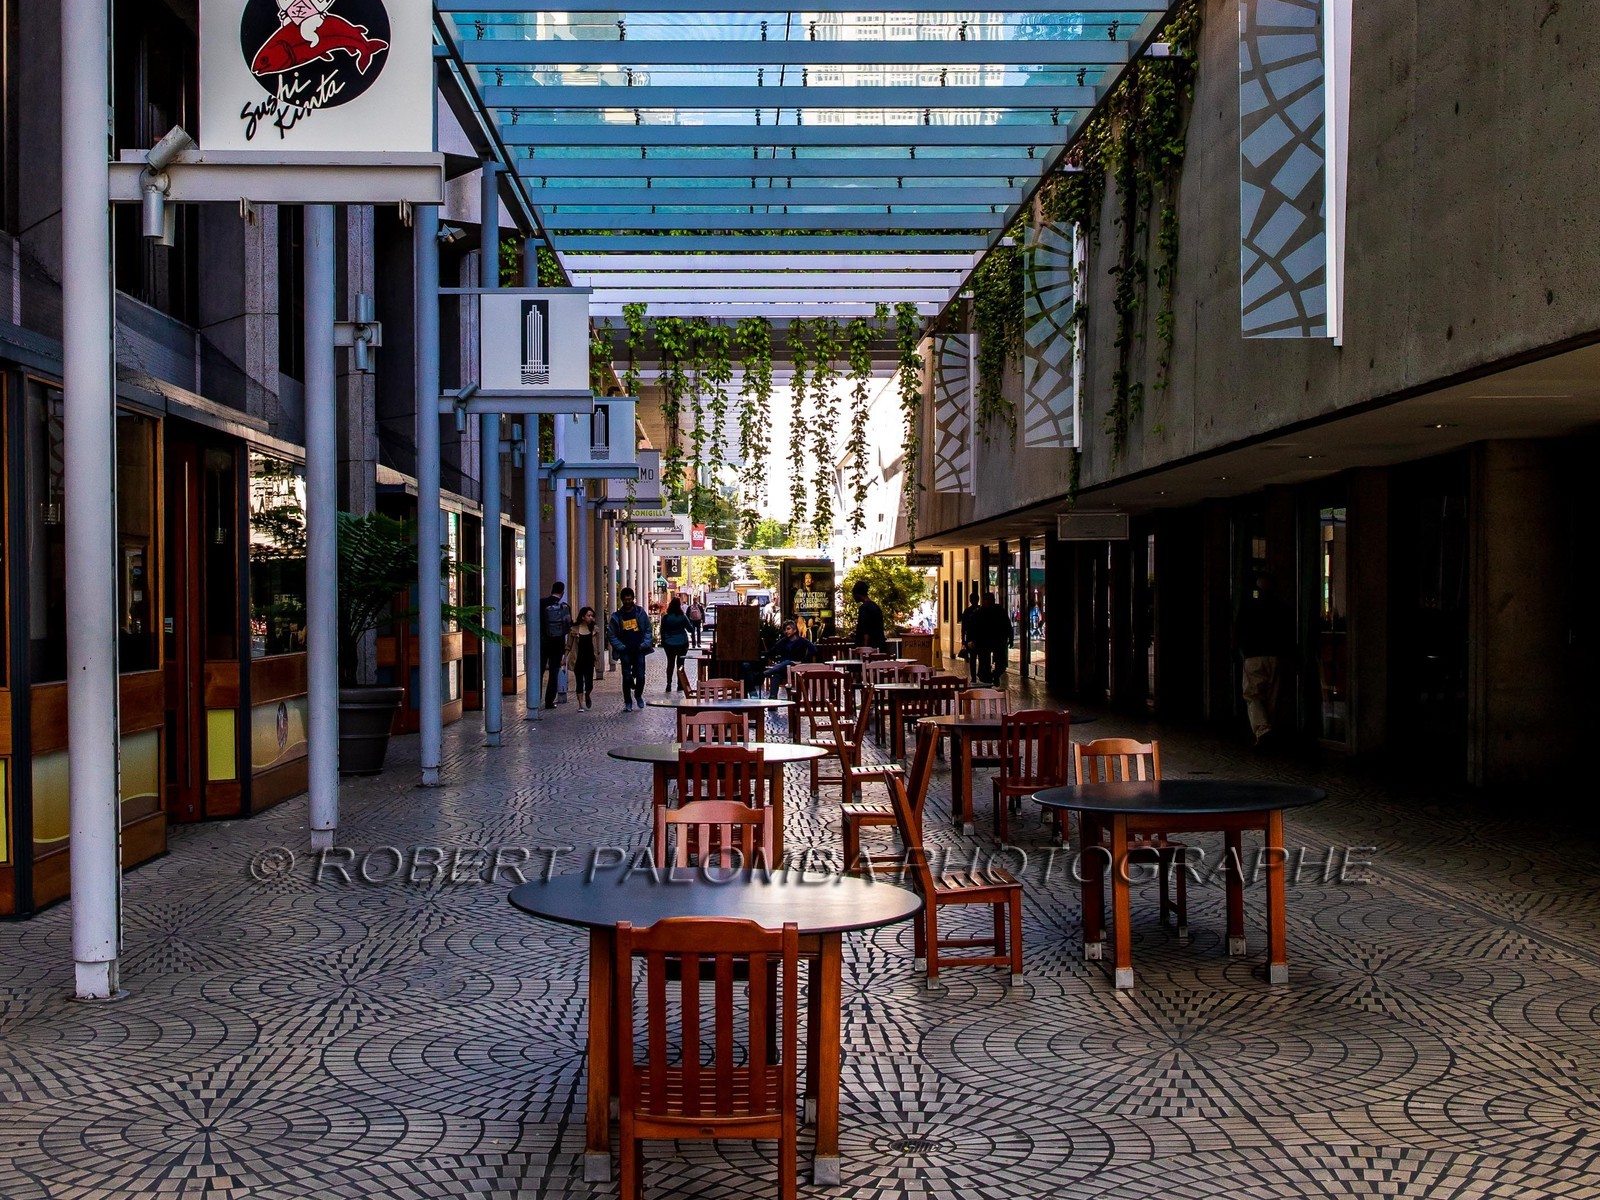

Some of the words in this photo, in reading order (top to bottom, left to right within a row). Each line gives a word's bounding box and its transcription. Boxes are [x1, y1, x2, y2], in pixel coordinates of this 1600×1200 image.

[240, 72, 311, 141] Sushi
[273, 69, 346, 139] Kinta
[635, 509, 667, 517] ONIGILLY
